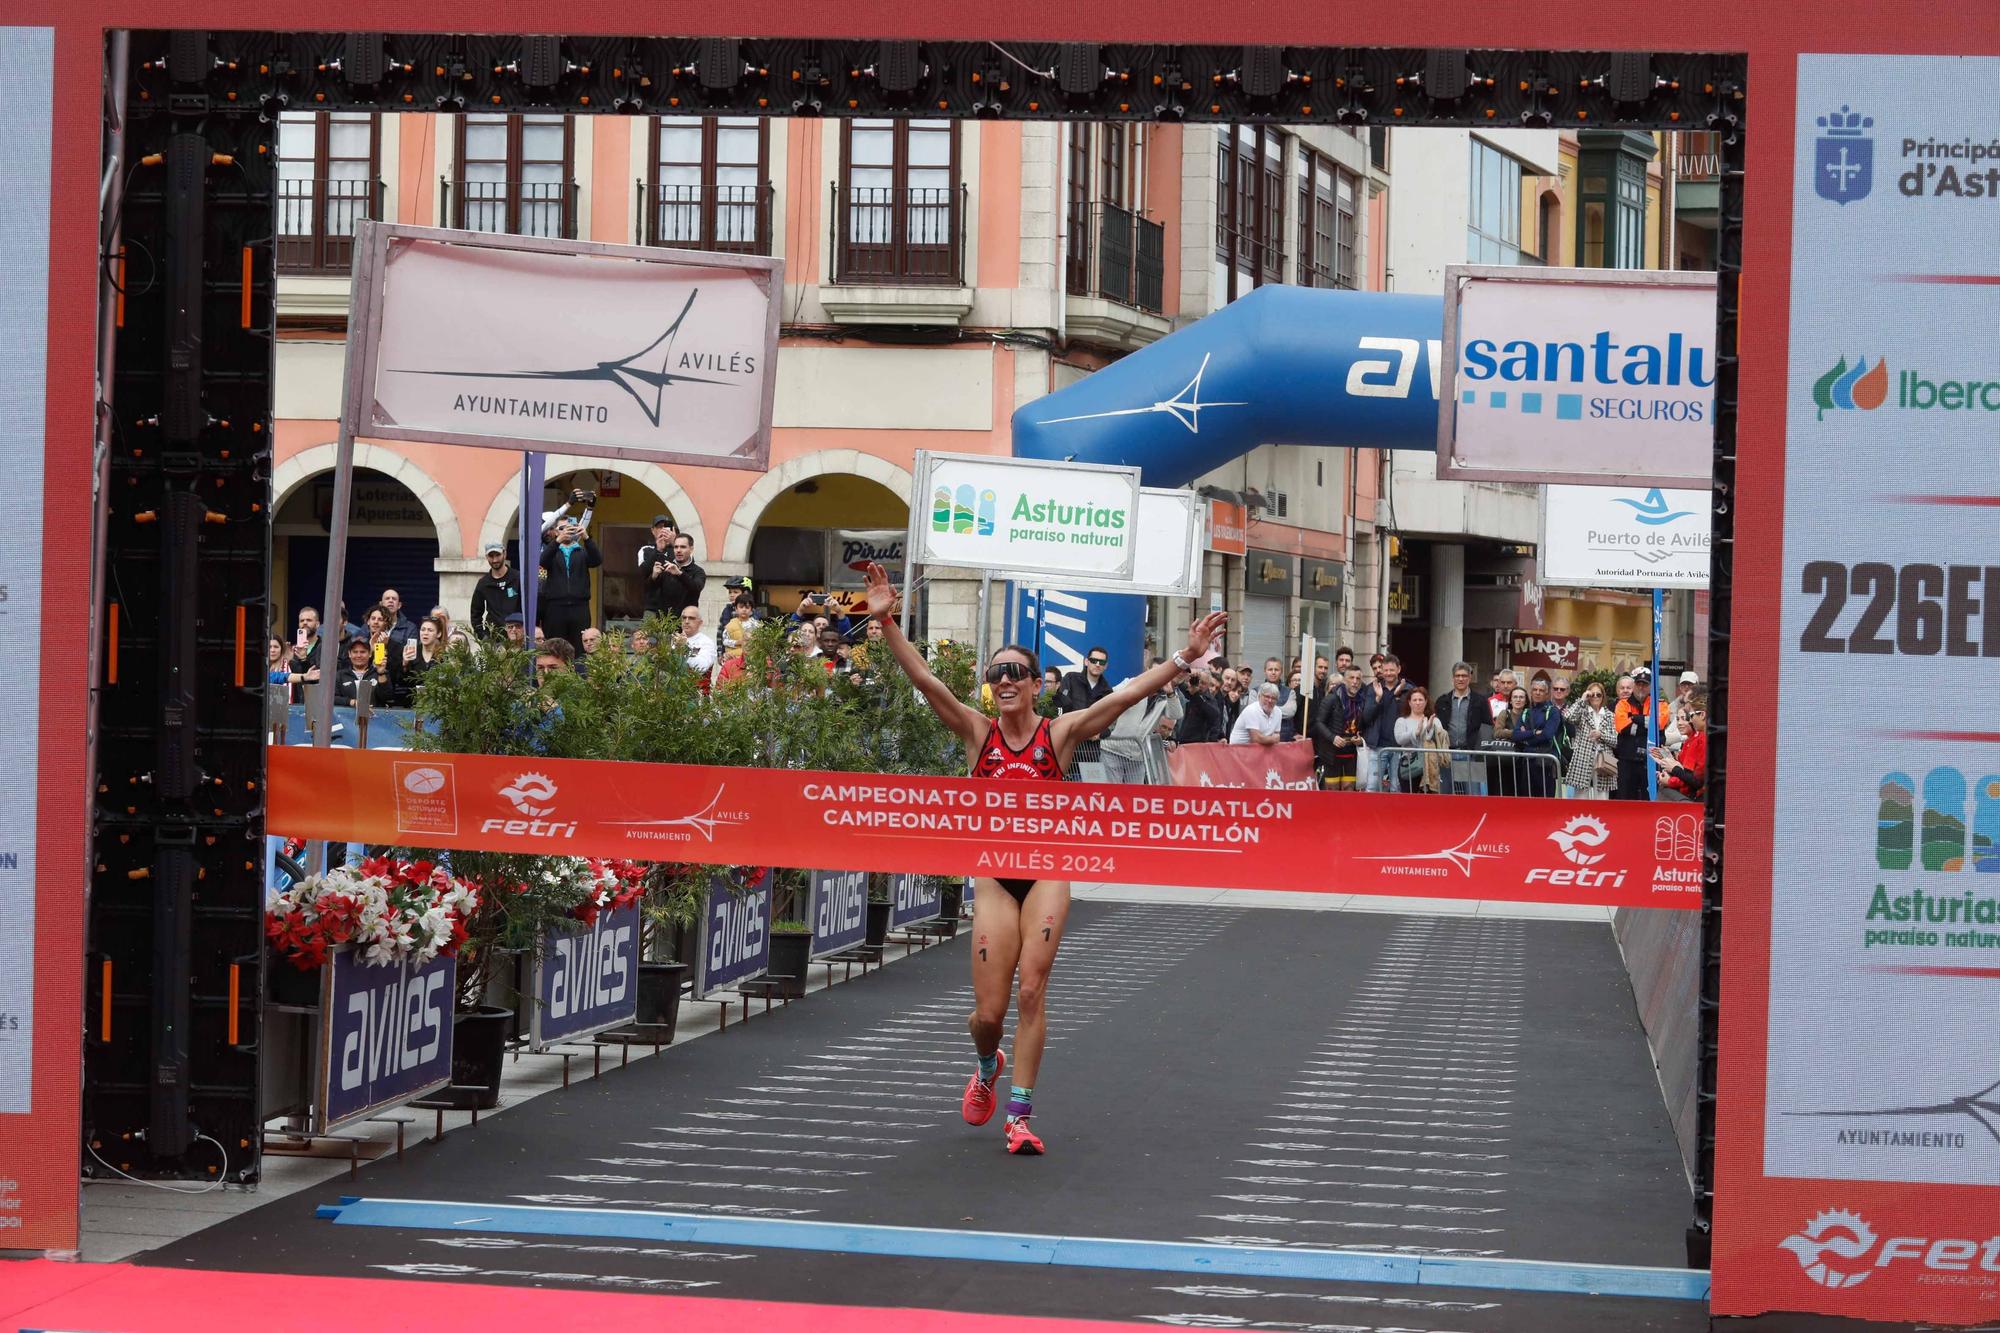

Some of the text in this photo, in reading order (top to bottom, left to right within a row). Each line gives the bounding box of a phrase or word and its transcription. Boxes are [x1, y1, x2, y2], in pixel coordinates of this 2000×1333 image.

[679, 352, 756, 374] AVILÉS
[453, 393, 609, 424] AYUNTAMIENTO
[1589, 397, 1704, 422] SEGUROS
[1011, 493, 1126, 529] Asturias
[1071, 532, 1124, 547] natural
[1587, 530, 1711, 547] Puerto de Avilé
[1595, 568, 1635, 577] Autoridad
[1636, 569, 1673, 578] Portuaria
[1674, 569, 1685, 578] de
[992, 762, 1039, 779] TRI INFINITY
[802, 783, 1293, 820] CAMPEONATO DE ESPAÑA DE DUATLÓN
[716, 810, 750, 821] AVILÉS
[823, 808, 1260, 844] CAMPEONATU D’ESPAÑA DE DUATLÓN
[626, 830, 691, 842] AYUNTAMIENTO
[1476, 843, 1511, 854] AVILÉS
[977, 850, 1116, 874] AVILÉS 2024
[1380, 865, 1448, 877] AYUNTAMIENTO
[1865, 883, 2000, 924] Asturia
[1041, 927, 1051, 942] 1
[978, 948, 987, 962] 1
[1837, 1129, 1964, 1149] AYUNTAMIENTO
